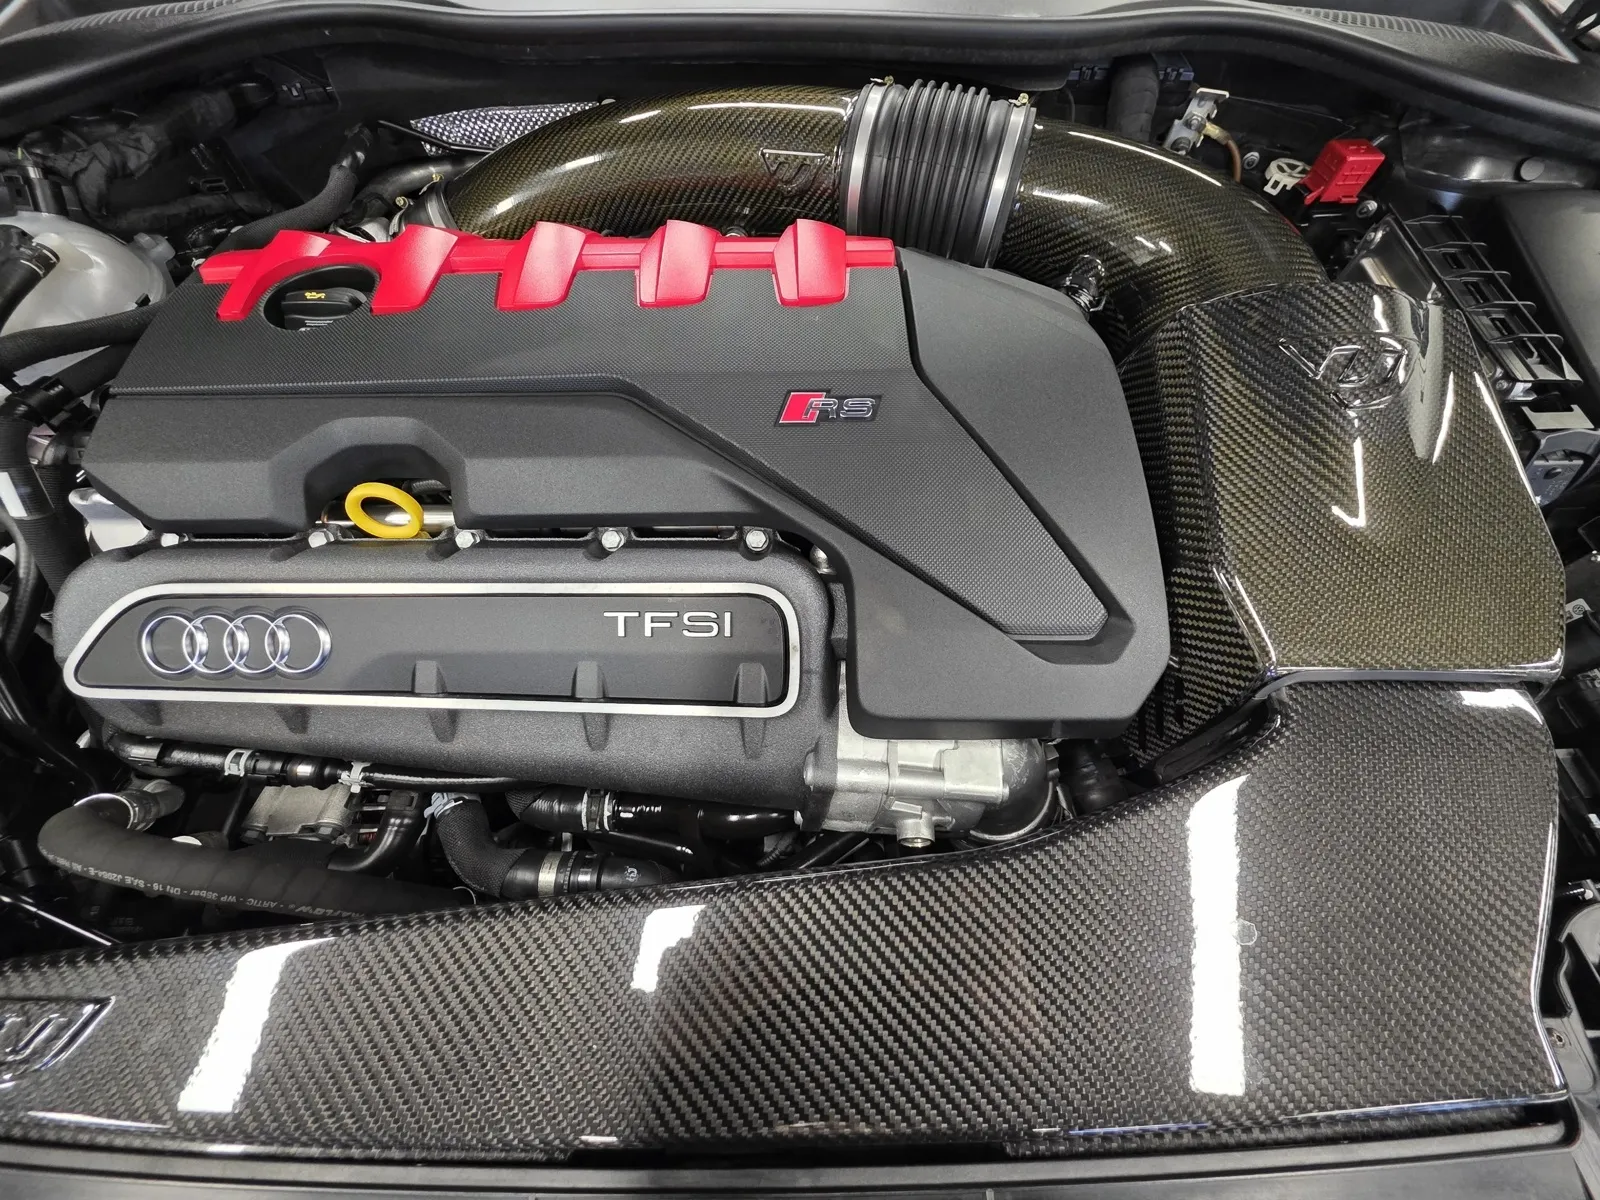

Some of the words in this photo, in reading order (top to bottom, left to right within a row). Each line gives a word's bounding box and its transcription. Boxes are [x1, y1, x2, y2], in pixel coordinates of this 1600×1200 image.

[800, 396, 876, 419] RS
[603, 611, 733, 638] TFSI
[124, 875, 146, 888] SAE
[189, 888, 219, 901] 35bar
[220, 894, 237, 903] WP
[246, 898, 279, 909] ARTIC
